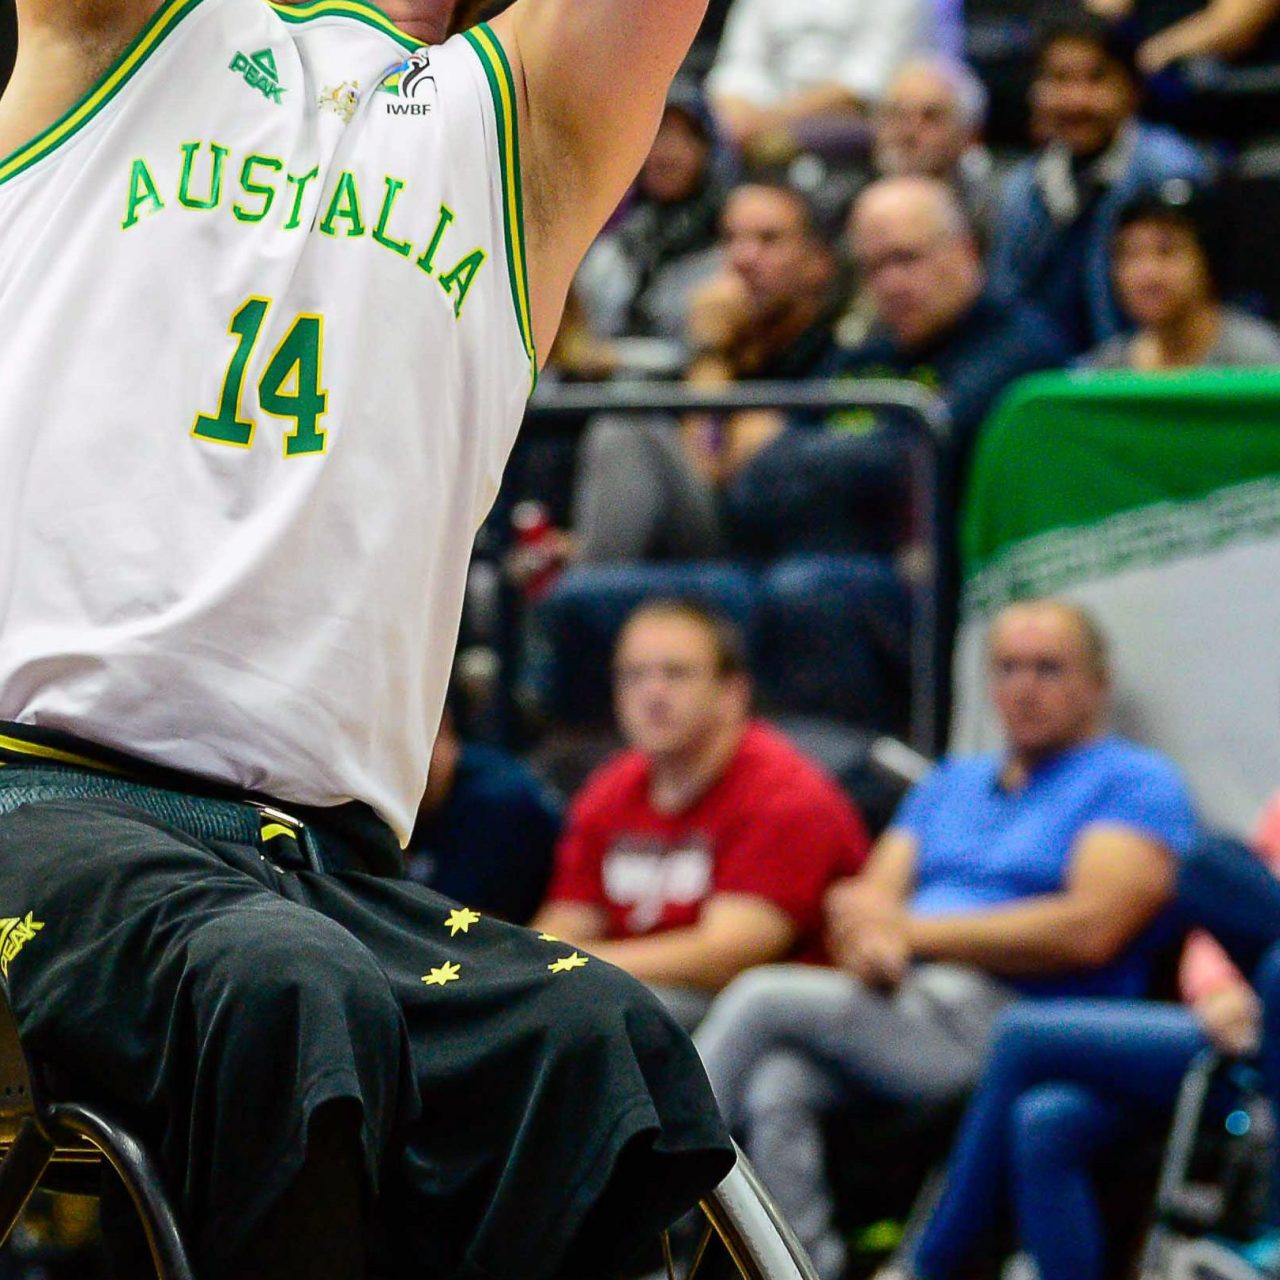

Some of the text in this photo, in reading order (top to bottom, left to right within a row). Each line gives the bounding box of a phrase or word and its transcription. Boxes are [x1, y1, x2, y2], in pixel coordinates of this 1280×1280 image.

[227, 50, 288, 106] PEAK
[386, 103, 432, 116] IWBF
[188, 293, 329, 459] 14
